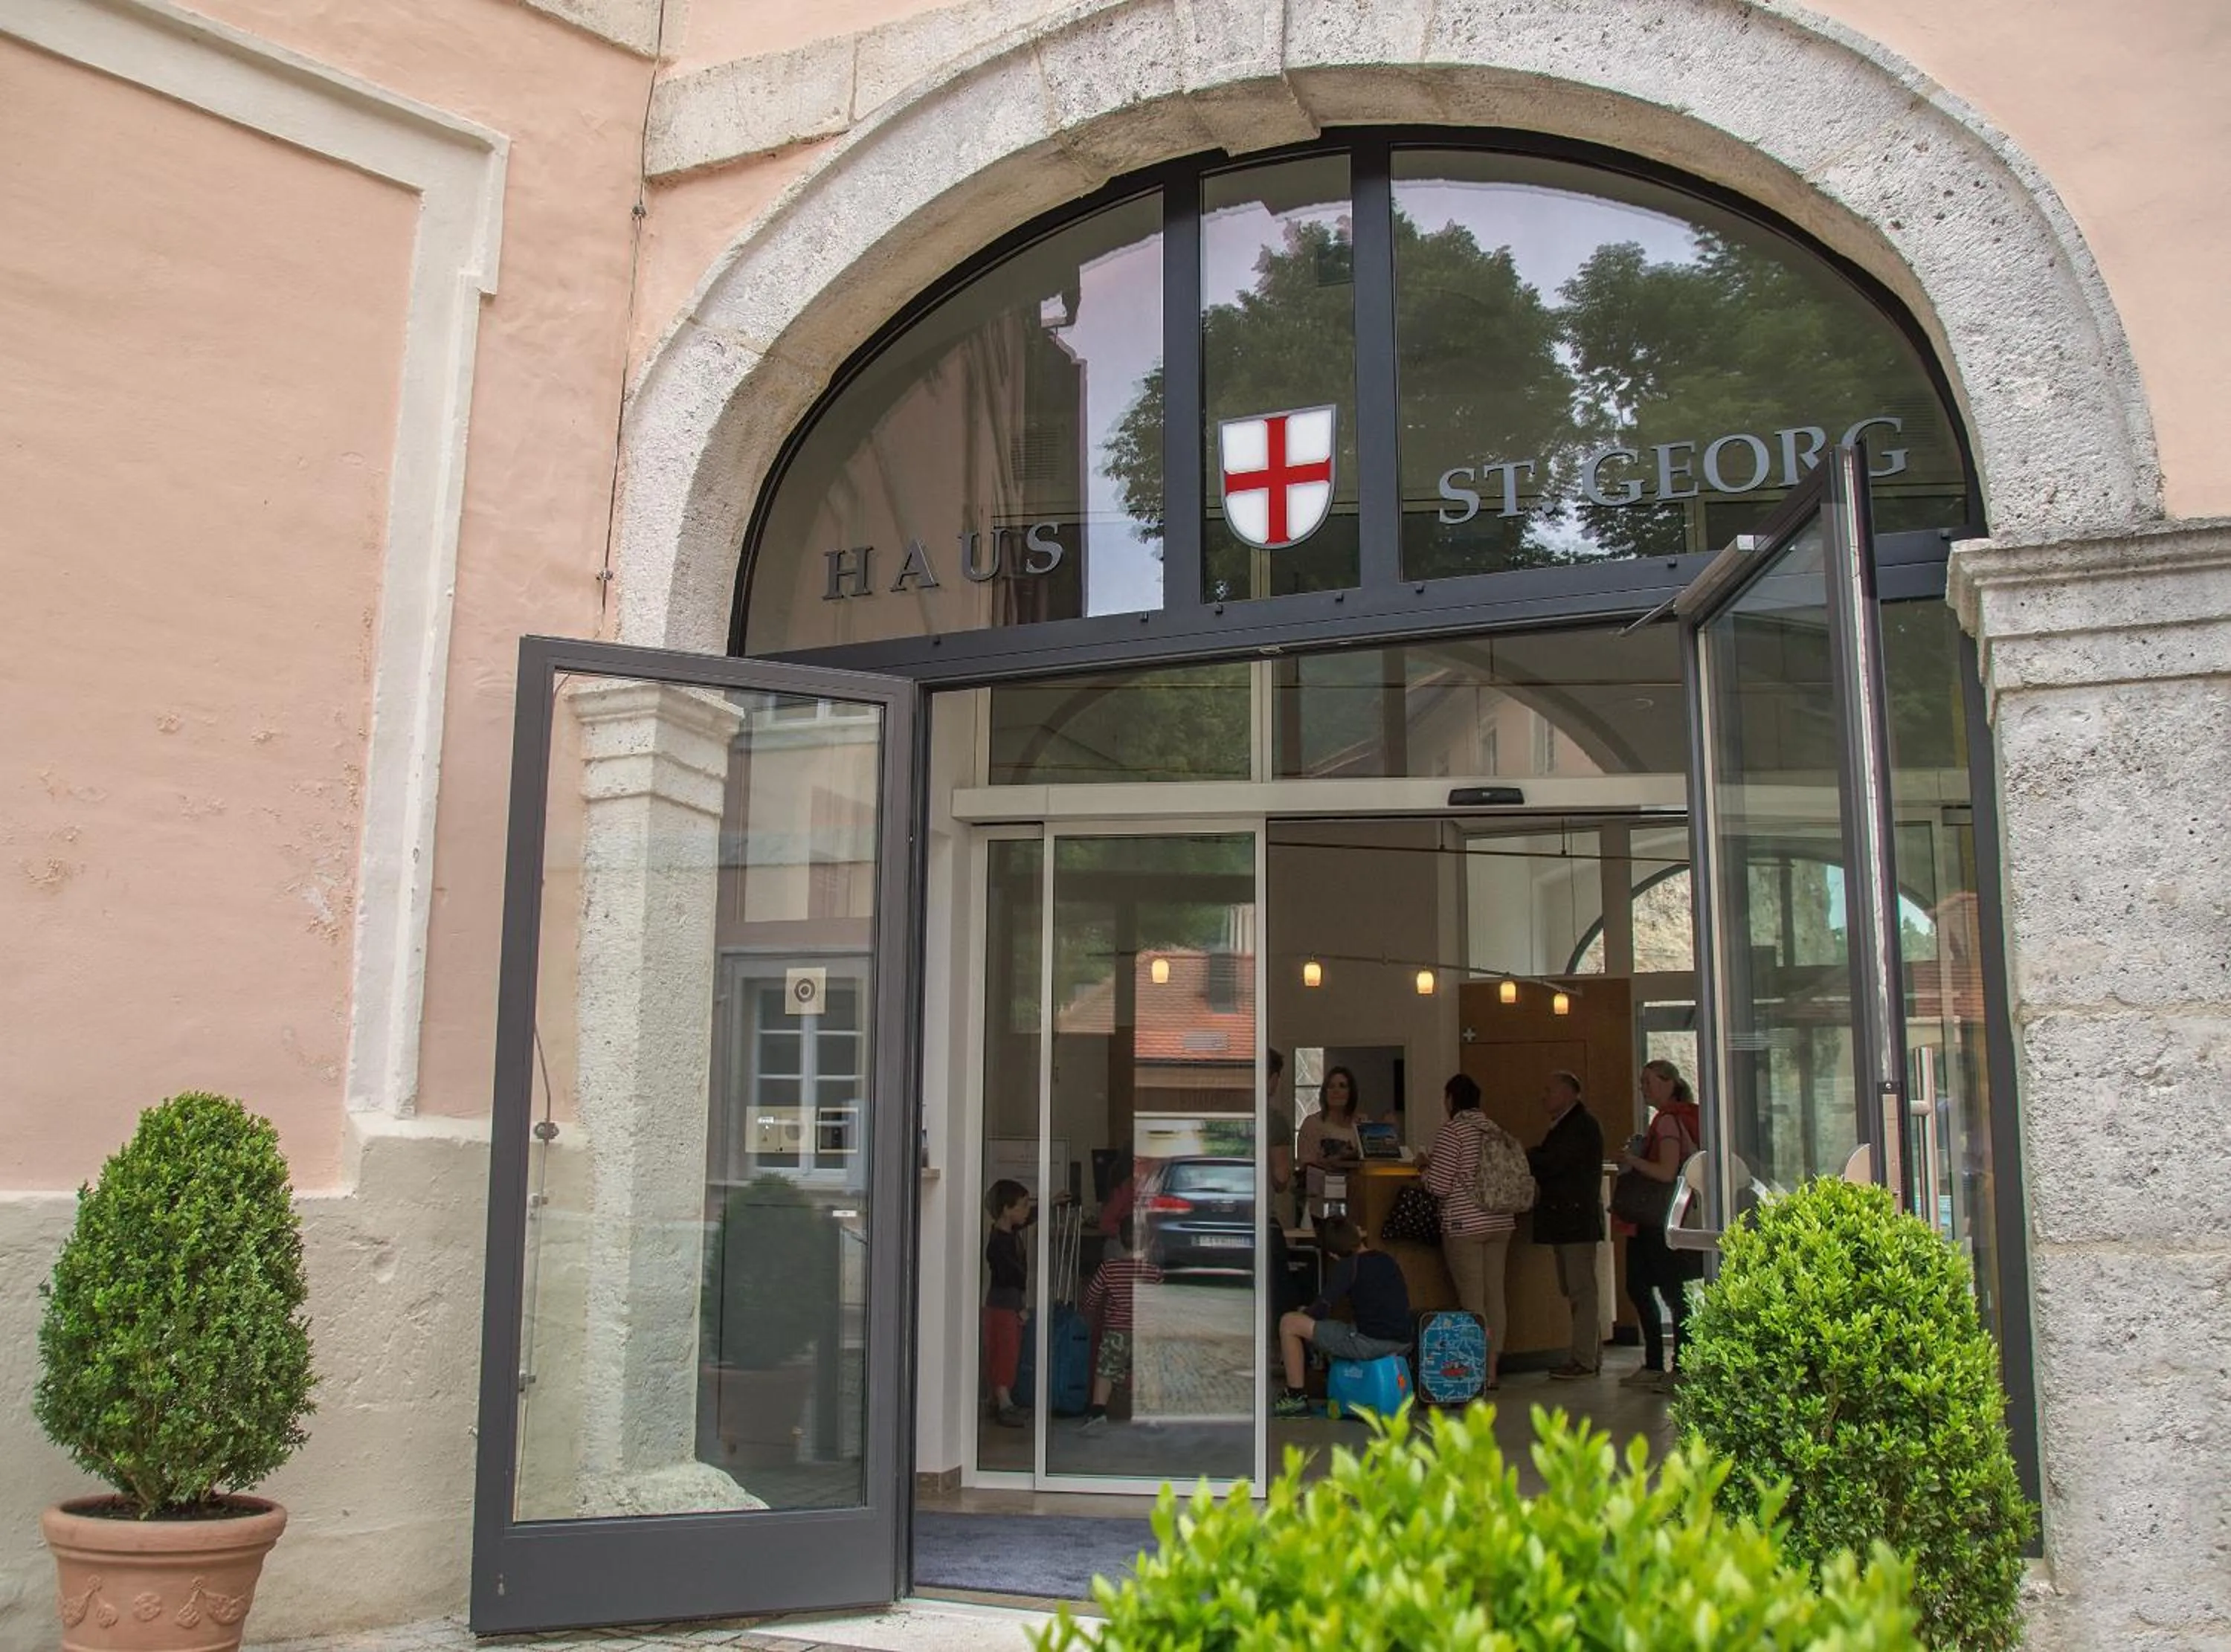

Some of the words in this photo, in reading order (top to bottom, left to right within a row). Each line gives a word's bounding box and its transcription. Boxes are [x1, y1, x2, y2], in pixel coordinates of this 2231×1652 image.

[822, 522, 1064, 601] HAUS
[1439, 459, 1556, 525] ST.
[1582, 417, 1909, 508] GEORG
